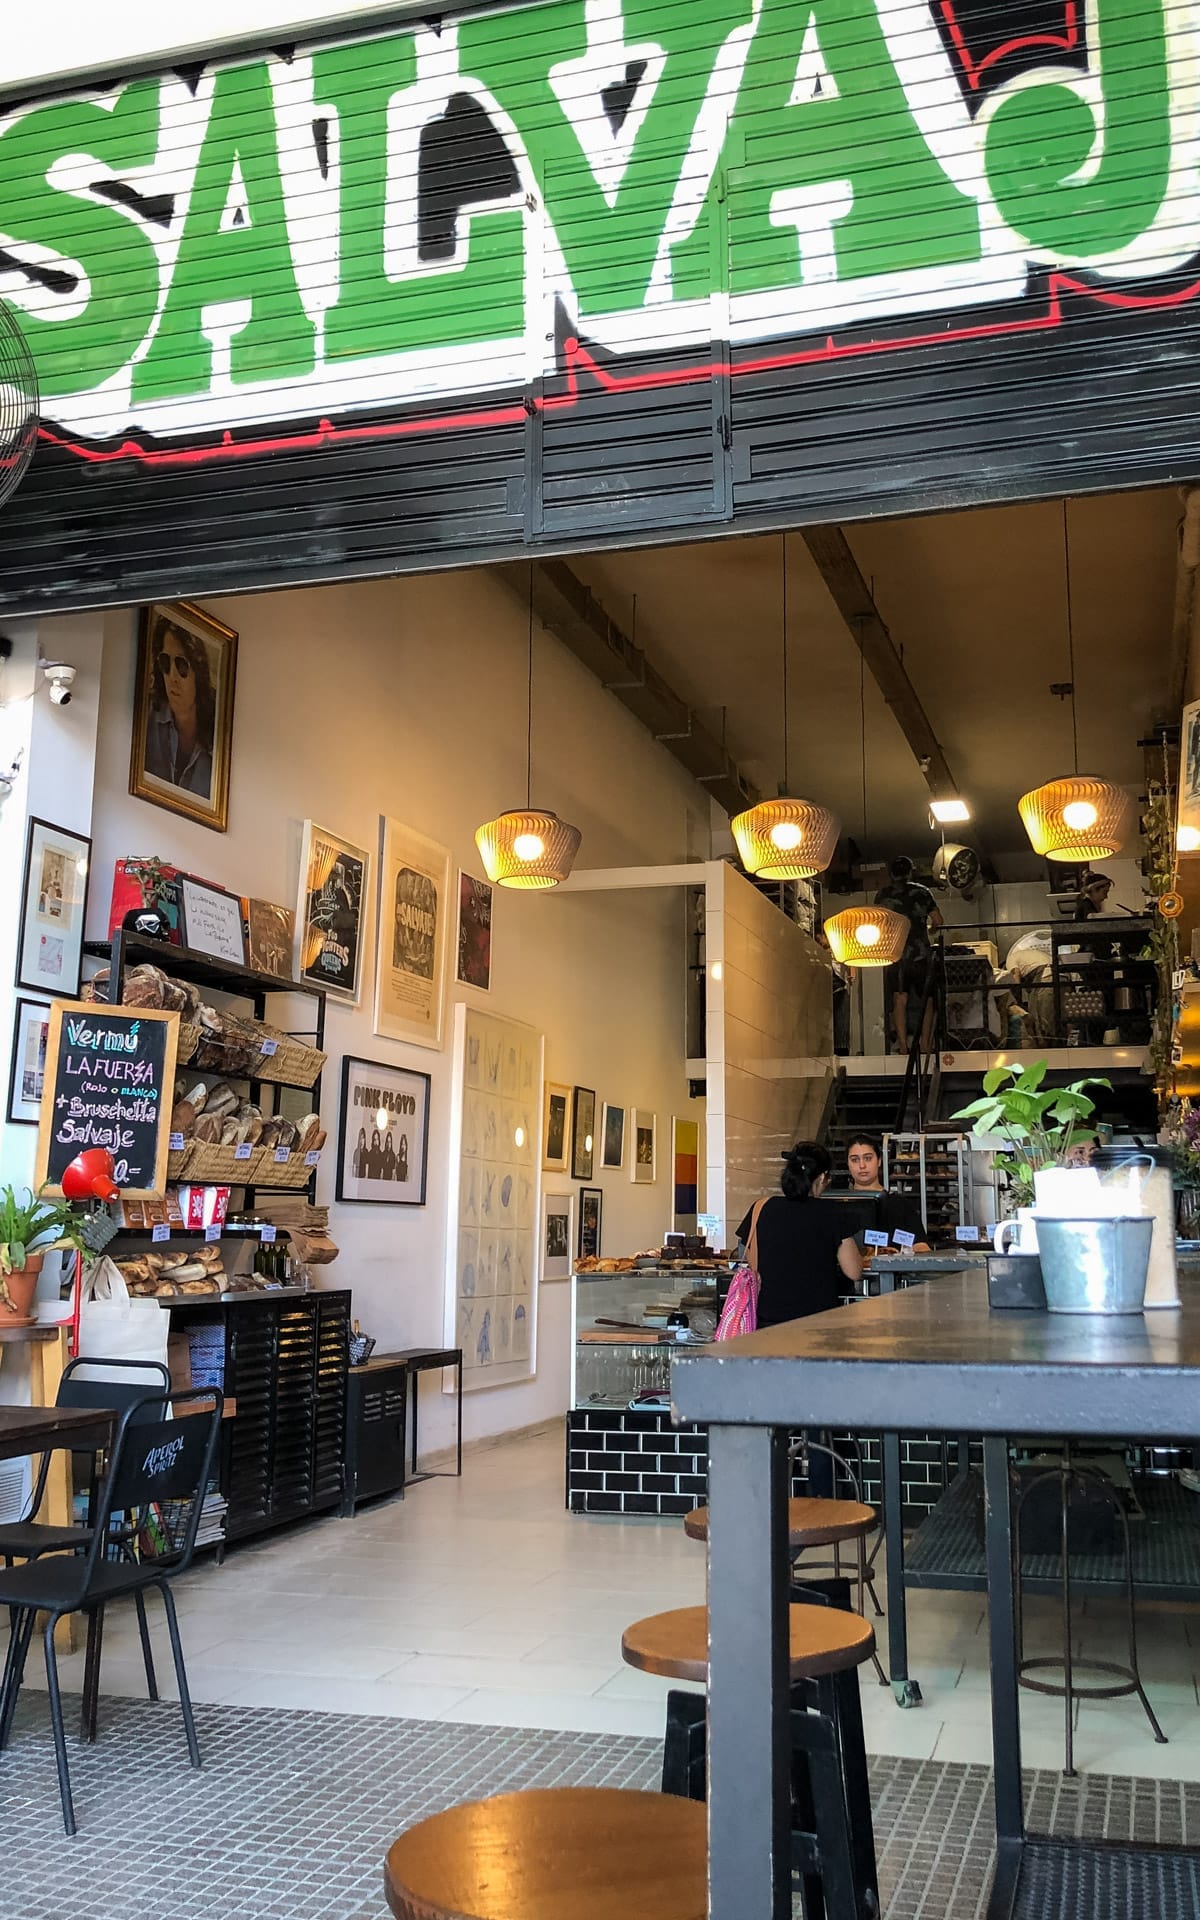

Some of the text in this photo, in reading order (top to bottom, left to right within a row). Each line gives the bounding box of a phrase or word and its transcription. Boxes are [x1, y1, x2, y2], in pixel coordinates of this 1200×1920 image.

[67, 1018, 140, 1053] Vermú
[65, 1056, 91, 1076] LA
[353, 1085, 416, 1116] PINK FLOYD
[56, 1119, 135, 1155] Salvaje
[142, 1435, 184, 1471] APEROL
[148, 1453, 177, 1478] SPRITZ
